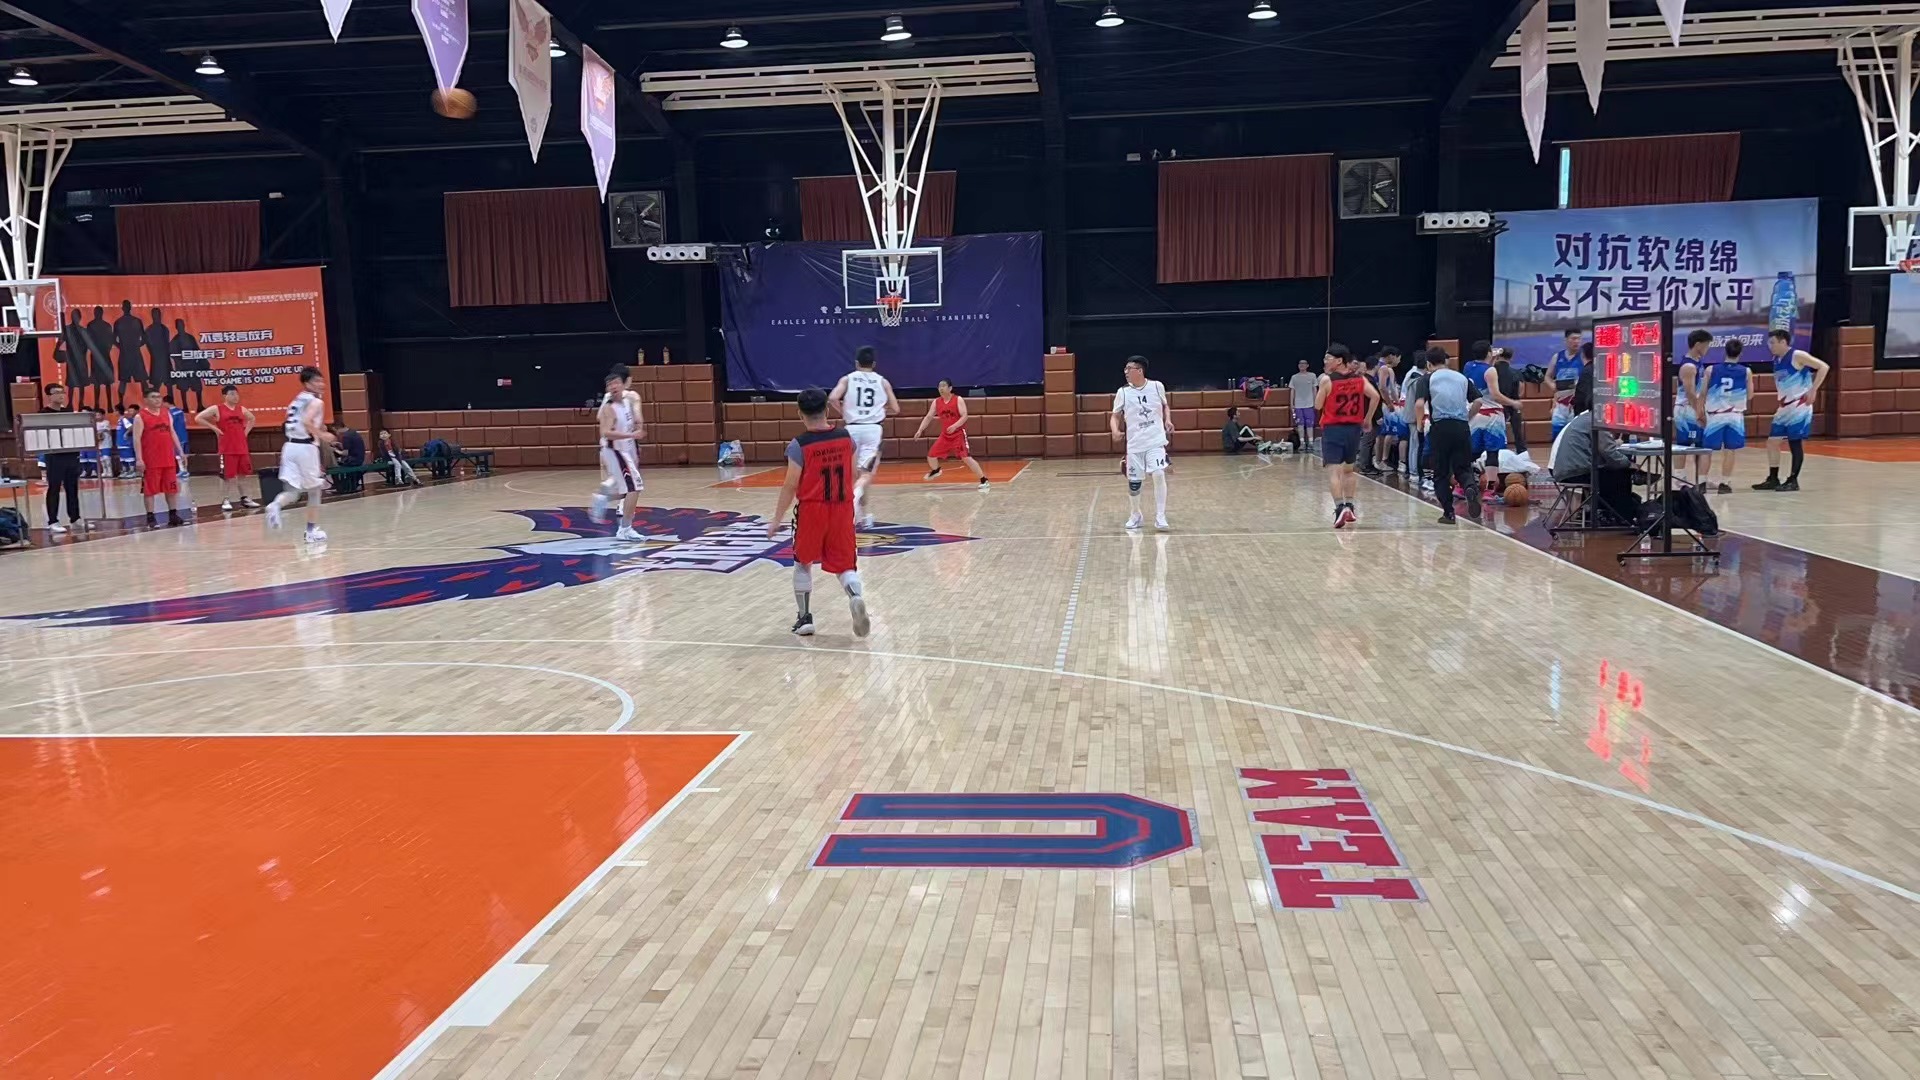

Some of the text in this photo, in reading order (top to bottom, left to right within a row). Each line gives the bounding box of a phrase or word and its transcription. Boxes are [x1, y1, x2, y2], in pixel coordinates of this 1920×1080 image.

[1553, 232, 1738, 274] 对抗软绵绵
[1533, 273, 1754, 312] 这不是你水平
[170, 370, 195, 378] DON'T
[195, 370, 214, 378] GIVE
[254, 367, 271, 375] YOU
[272, 366, 292, 374] GIVE
[220, 377, 243, 385] GAME
[244, 376, 253, 384] IS
[253, 375, 275, 383] OVER
[856, 386, 875, 407] 13
[1720, 377, 1734, 397] 2
[1137, 395, 1147, 404] 14
[1335, 392, 1360, 416] 23
[1156, 458, 1164, 466] 14
[821, 465, 844, 501] 11
[1239, 767, 1428, 910] TEAM
